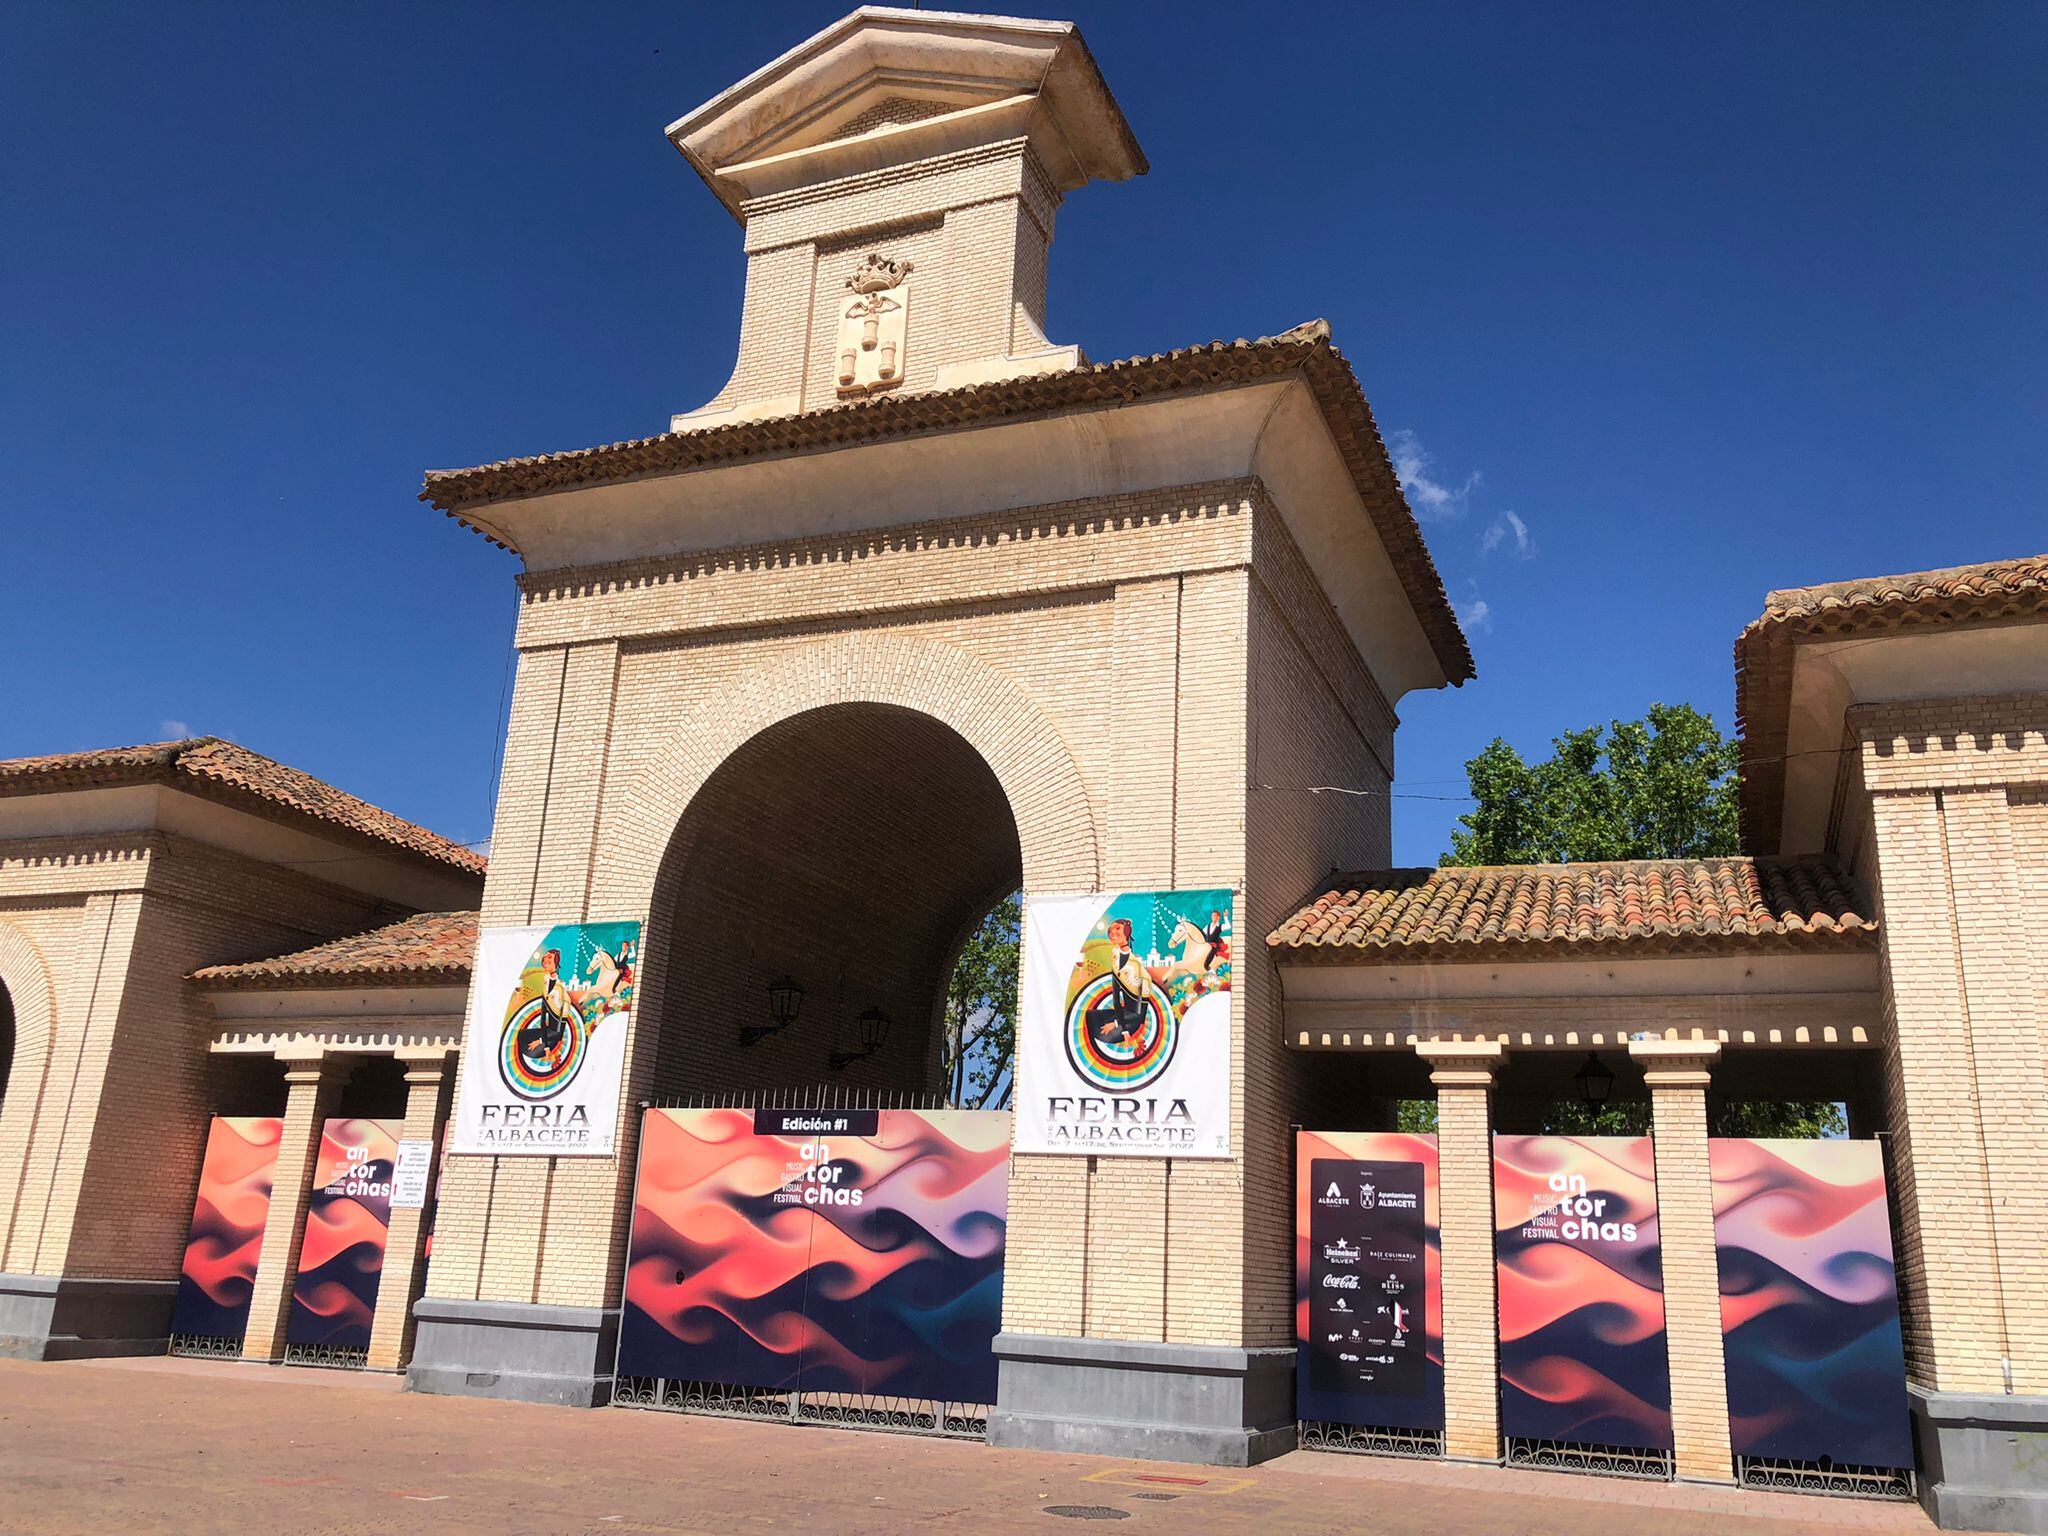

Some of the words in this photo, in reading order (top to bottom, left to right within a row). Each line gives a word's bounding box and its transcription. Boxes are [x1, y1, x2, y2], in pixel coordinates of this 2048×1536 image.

[478, 1105, 592, 1127] FERIA
[1046, 1097, 1196, 1124] FERIA
[782, 1117, 832, 1131] Edición
[834, 1118, 848, 1131] #1
[485, 1130, 590, 1142] ALBACETE
[1055, 1126, 1196, 1142] ALBACETE
[350, 1163, 377, 1179] tor
[807, 1162, 842, 1184] tor
[346, 1180, 390, 1197] chas
[804, 1185, 863, 1206] chas
[773, 1193, 802, 1204] FESTIVAL
[1379, 1199, 1416, 1208] ALBACETE
[1533, 1194, 1557, 1203] MUSIC
[1559, 1196, 1606, 1217] tor
[1531, 1217, 1558, 1227] VISUAL
[1561, 1218, 1637, 1242] chas
[1522, 1228, 1559, 1239] FESTIVAL
[1326, 1248, 1359, 1257] Heineken
